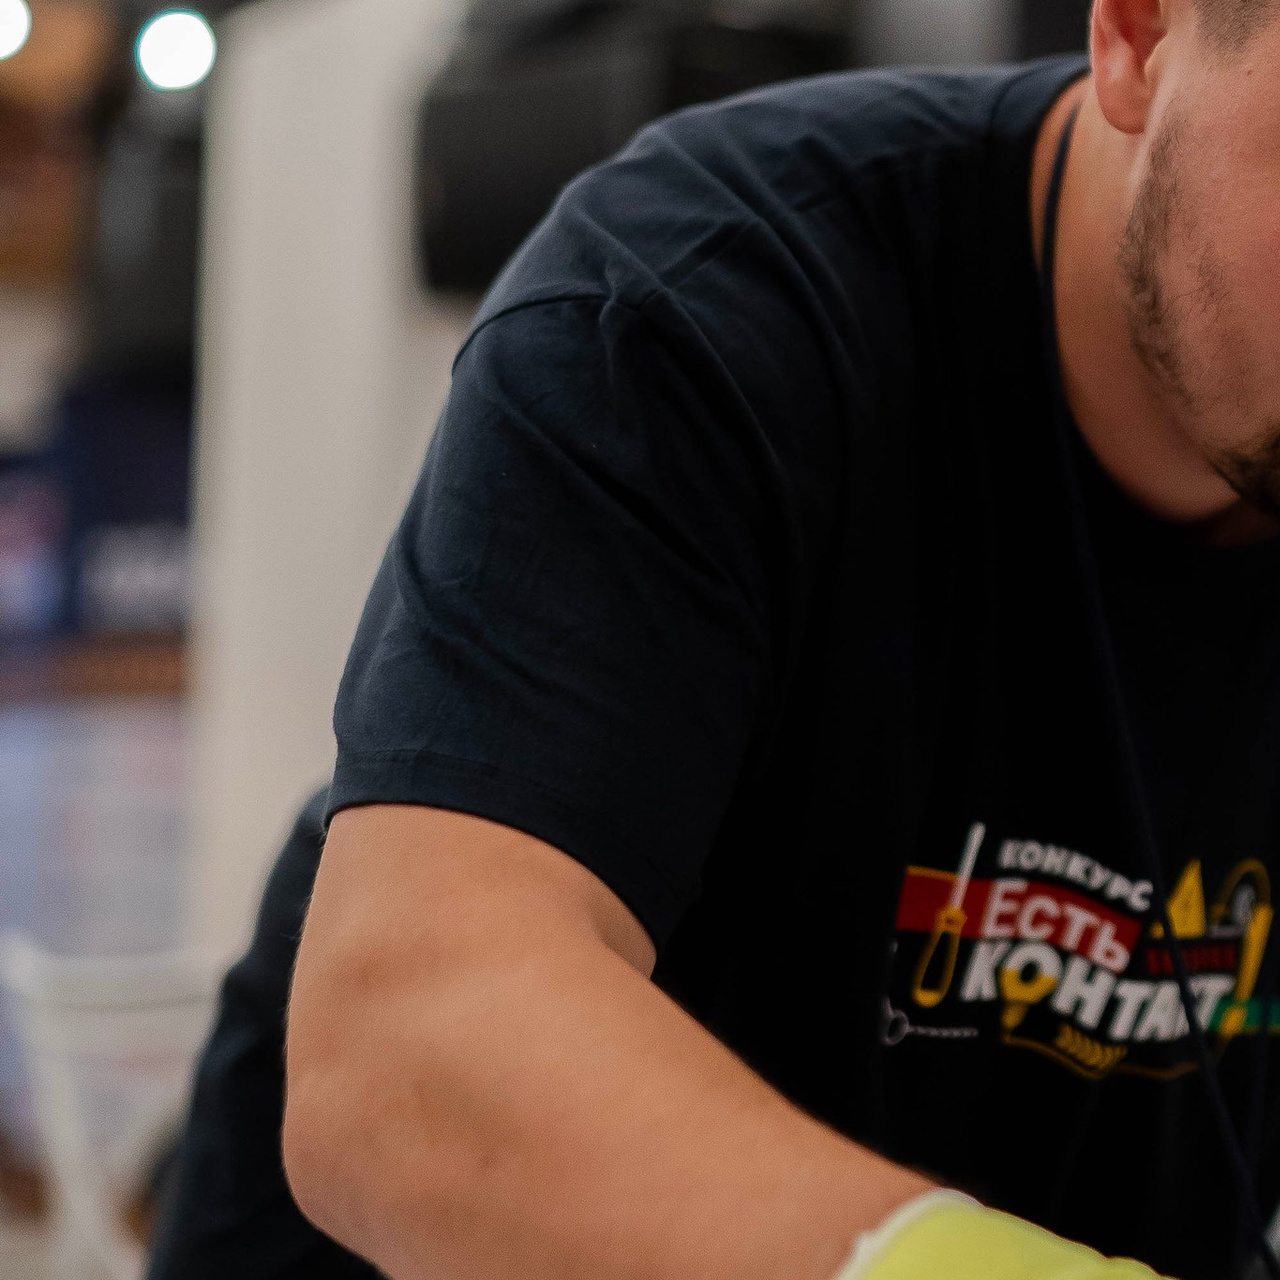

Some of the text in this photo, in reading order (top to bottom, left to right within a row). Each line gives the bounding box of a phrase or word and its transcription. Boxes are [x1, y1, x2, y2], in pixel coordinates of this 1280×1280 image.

[999, 838, 1154, 911] КОНКУРС
[979, 877, 1131, 974] ЕСТЬ
[960, 939, 1237, 1041] КОНТАТ
